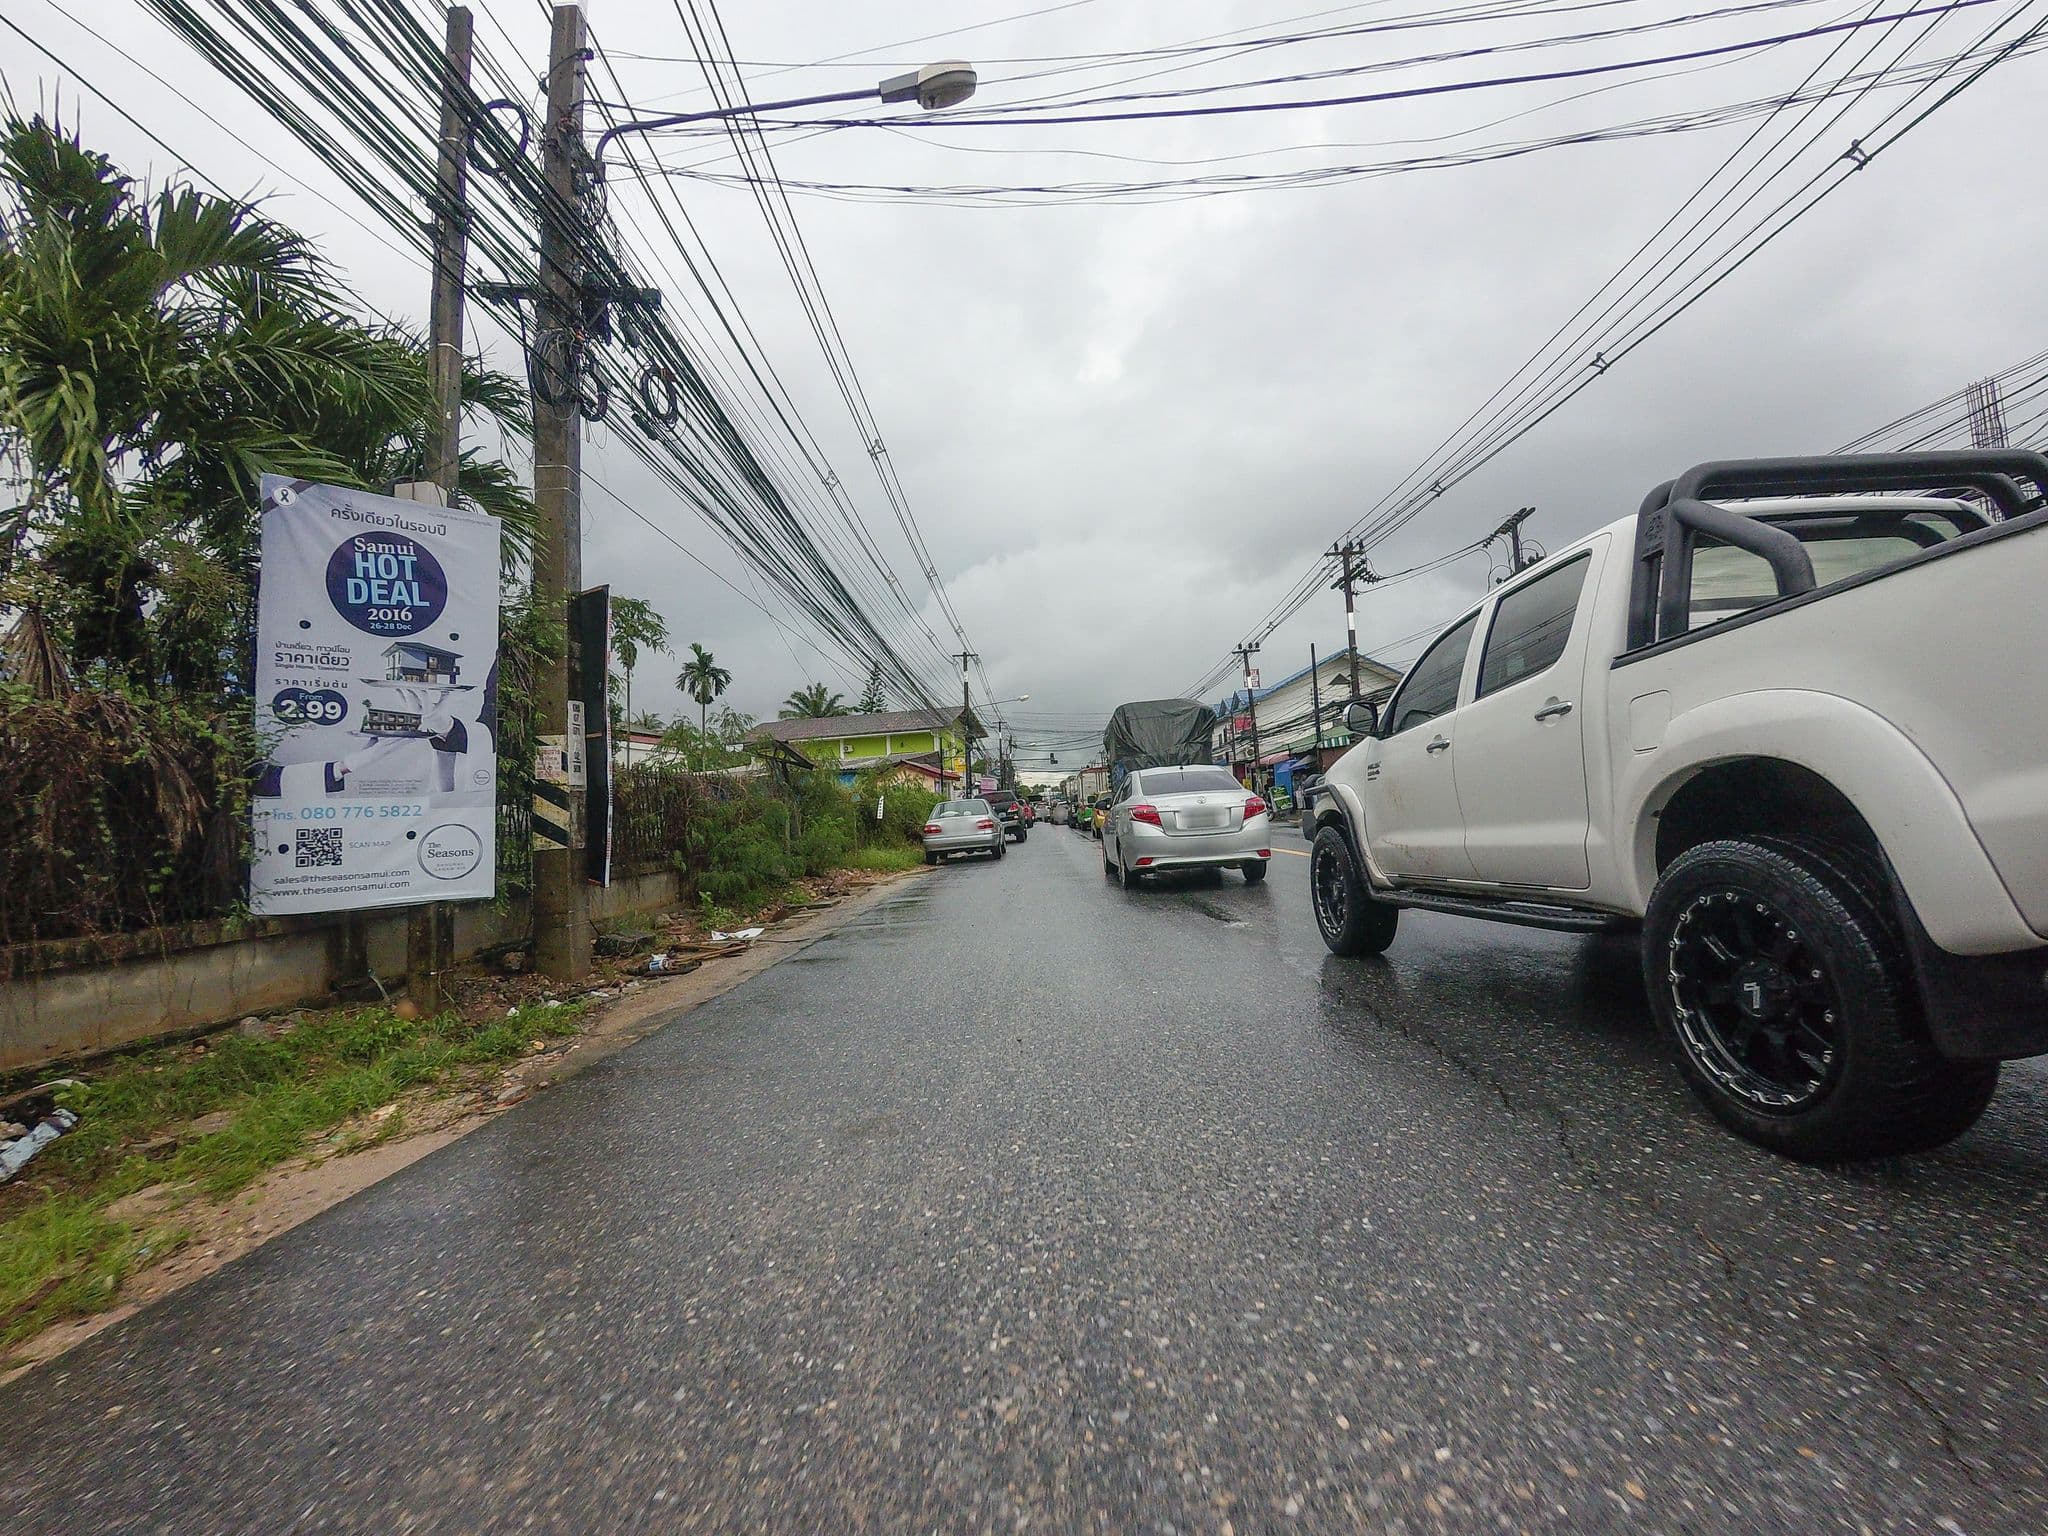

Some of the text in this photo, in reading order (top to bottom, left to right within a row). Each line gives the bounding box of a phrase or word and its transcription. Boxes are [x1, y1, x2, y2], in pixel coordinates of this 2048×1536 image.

[331, 503, 447, 537] ครั้งเดียวในรอบปี
[354, 537, 416, 556] Samui
[354, 551, 418, 581] HOT
[346, 577, 431, 607] DEAL
[367, 606, 413, 622] 2016
[370, 622, 412, 631] 26-28 Dec
[299, 692, 323, 701] From
[280, 699, 342, 720] 2.99
[300, 807, 336, 820] 080
[342, 806, 375, 818] 776
[379, 805, 422, 818] 5822
[349, 840, 391, 849] SCAN MAP
[427, 847, 474, 859] Seasons
[273, 869, 411, 885] sales@theseasonsamui.com
[271, 880, 410, 897] www.theseasonsamui.com
